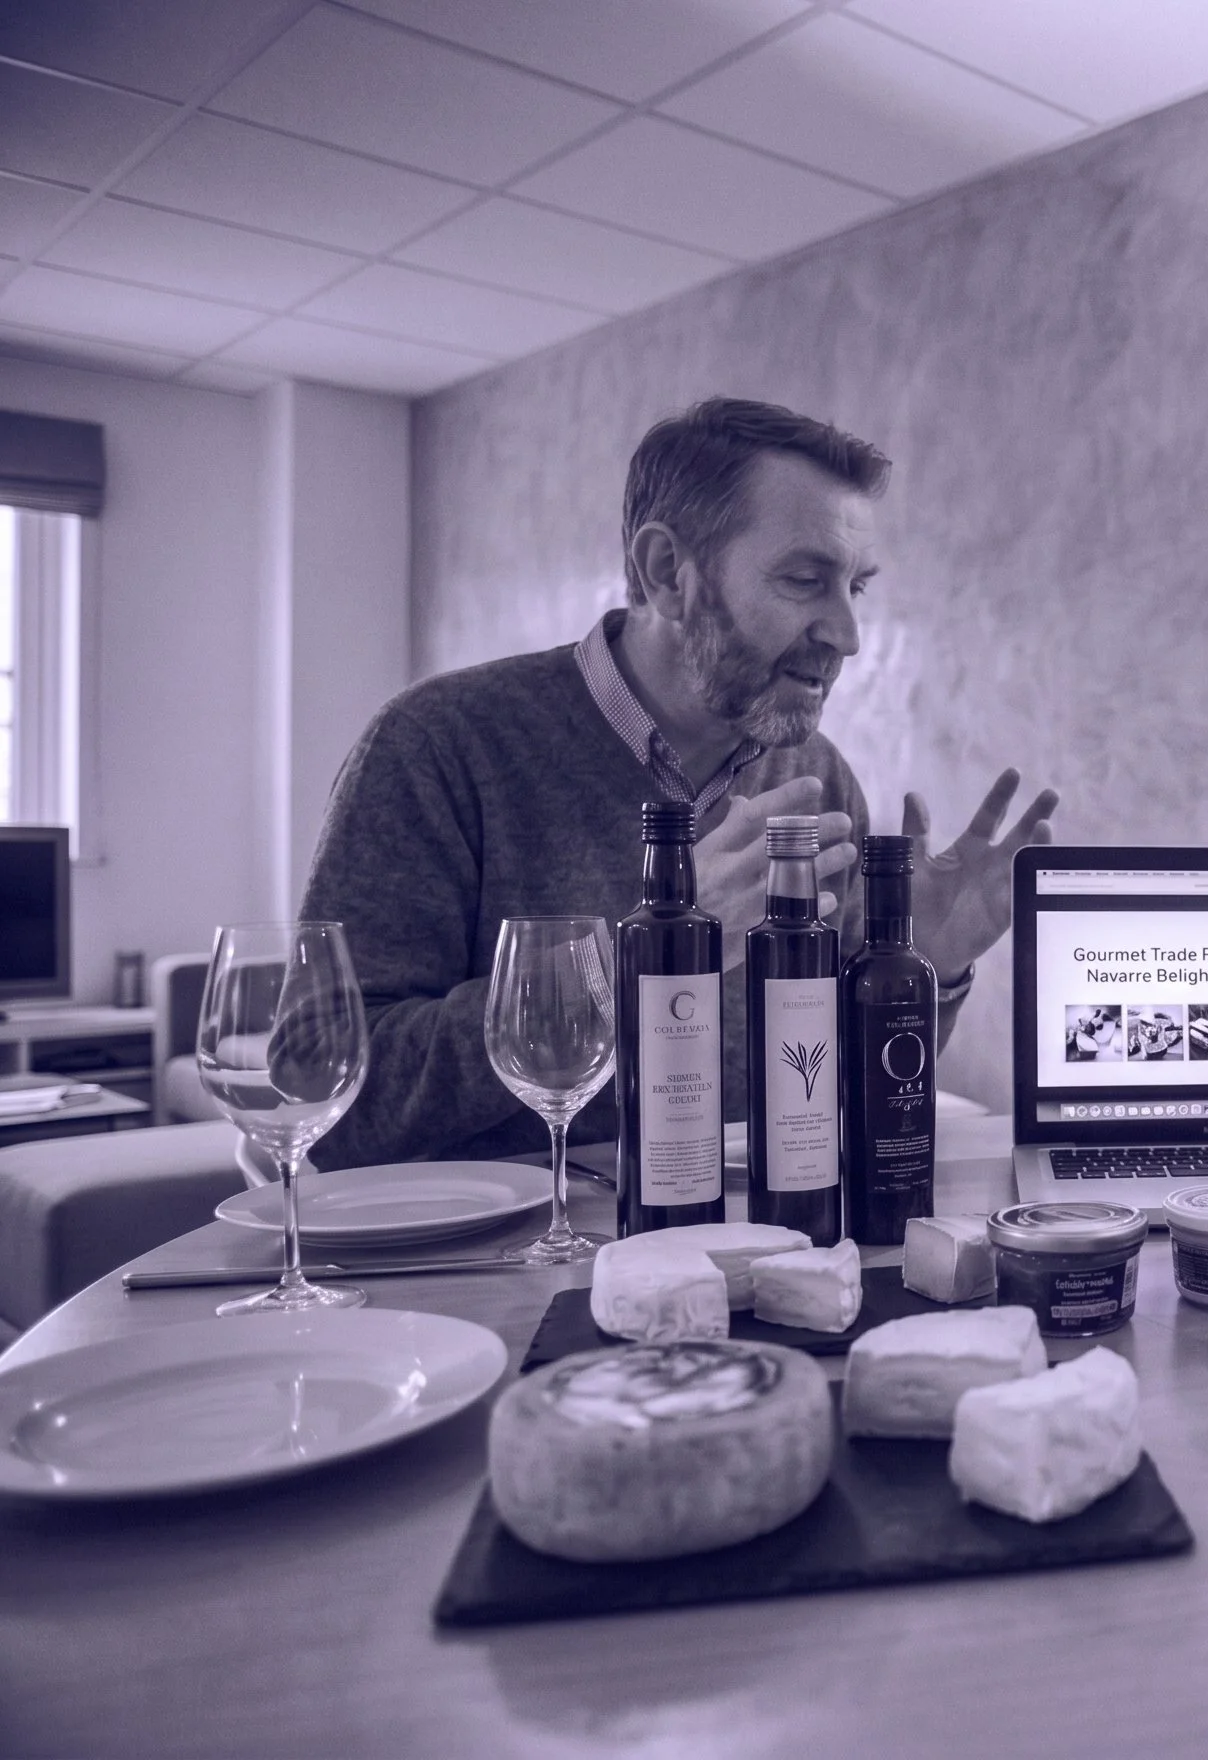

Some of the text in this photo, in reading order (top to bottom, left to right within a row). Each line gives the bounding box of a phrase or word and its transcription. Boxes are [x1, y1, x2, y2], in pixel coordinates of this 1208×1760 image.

[1073, 947, 1147, 962] Gourmet
[1150, 947, 1198, 962] Trade
[1087, 968, 1152, 983] Navarre
